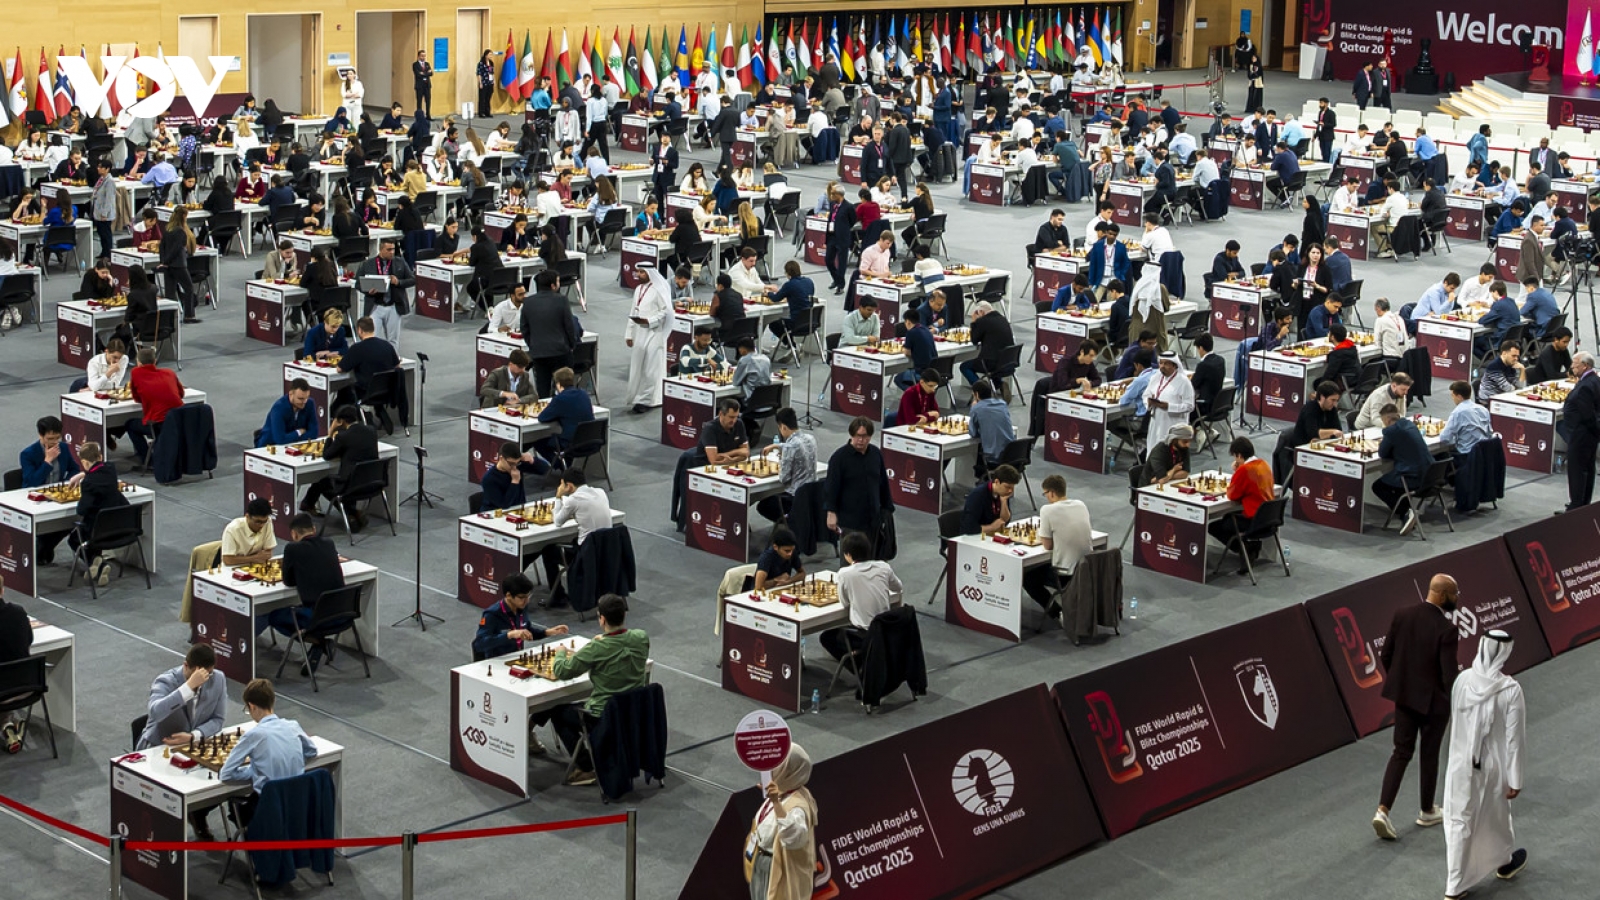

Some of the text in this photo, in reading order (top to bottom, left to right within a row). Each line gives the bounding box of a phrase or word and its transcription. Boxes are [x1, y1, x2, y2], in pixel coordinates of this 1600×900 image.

[1340, 31, 1413, 45] Blitz Champiships
[1341, 22, 1413, 36] FIDE World Rpid &
[1340, 41, 1397, 56] Qatar 205
[1570, 589, 1592, 604] Qatar
[1135, 722, 1153, 736] FIDE
[1152, 713, 1176, 730] World
[1174, 705, 1197, 721] Rapid
[1139, 718, 1210, 750] Blitz Championships
[1145, 736, 1202, 771] Qatar 2025
[985, 802, 1003, 817] FIDE
[831, 807, 919, 851] FIDE World Rapid &
[836, 824, 925, 866] Blitz Championships
[843, 846, 914, 889] Qatar 2025
